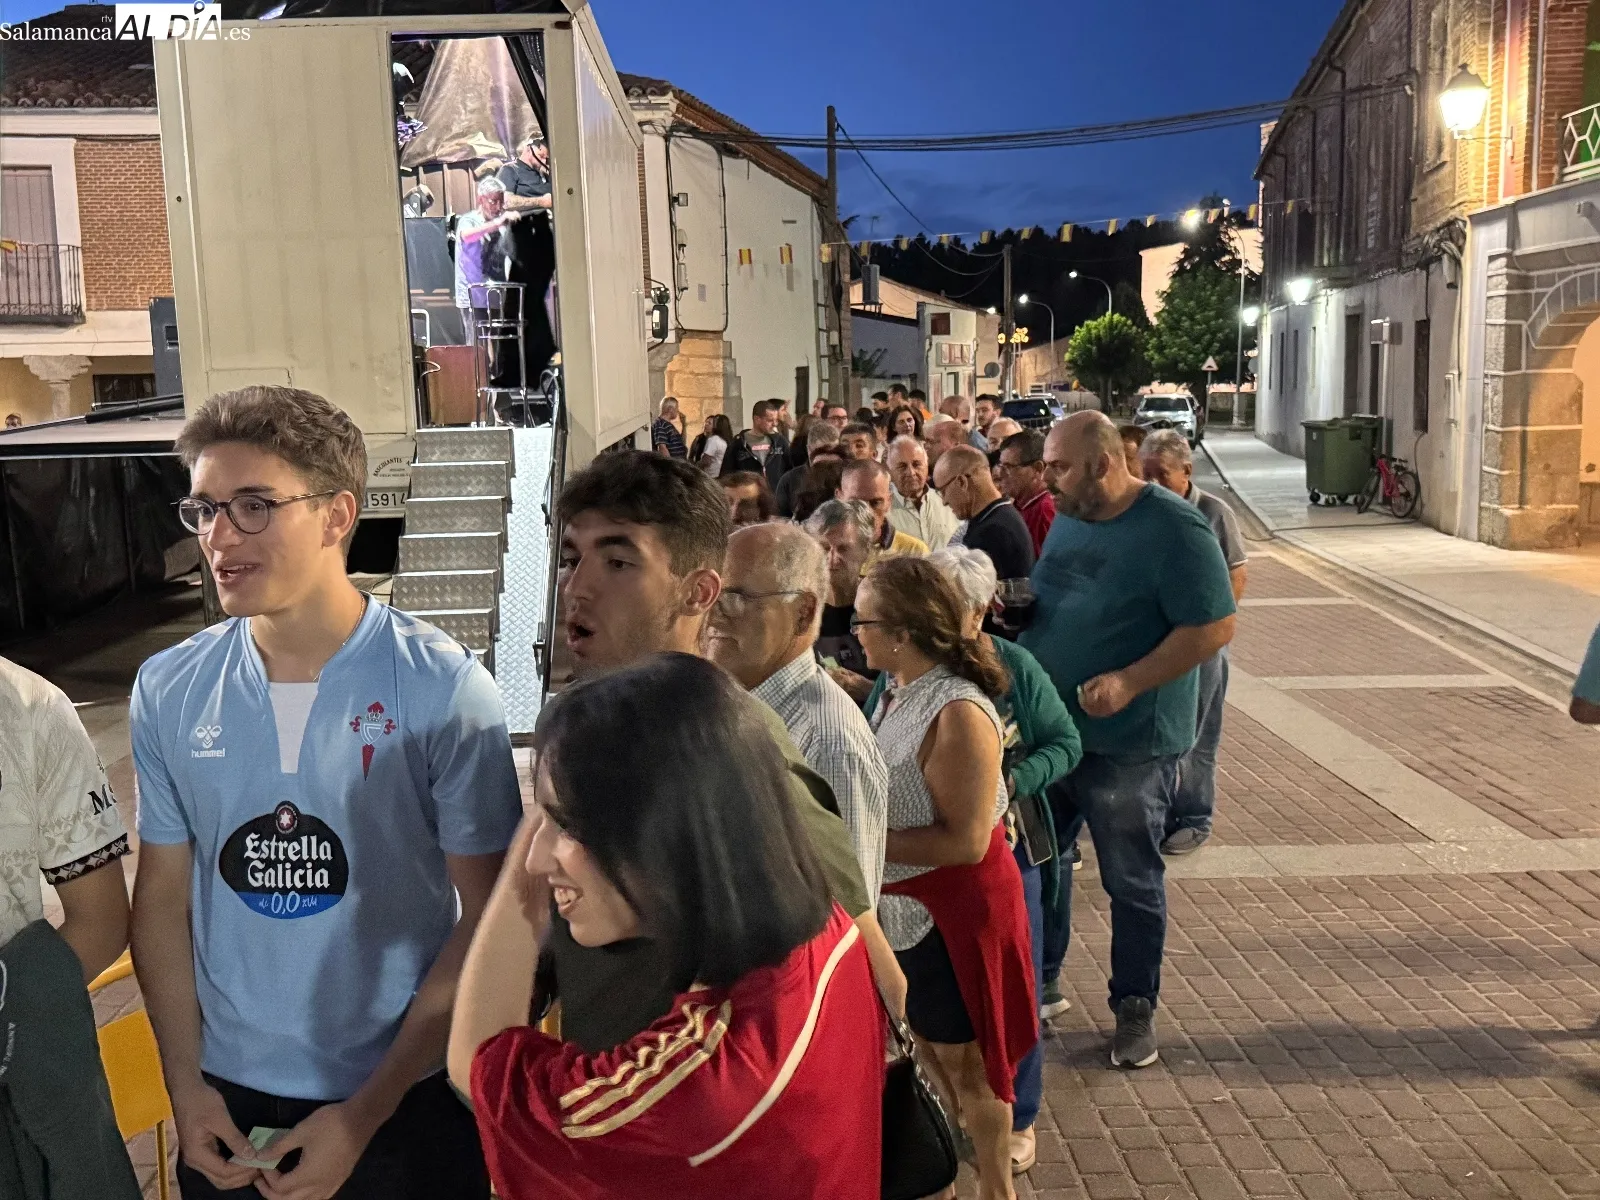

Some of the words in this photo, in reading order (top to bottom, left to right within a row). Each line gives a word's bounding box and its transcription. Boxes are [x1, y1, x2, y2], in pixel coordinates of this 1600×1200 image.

[191, 747, 226, 759] hummel
[243, 832, 333, 861] Estrella
[246, 859, 331, 890] Galicia
[270, 890, 301, 914] 0,0
